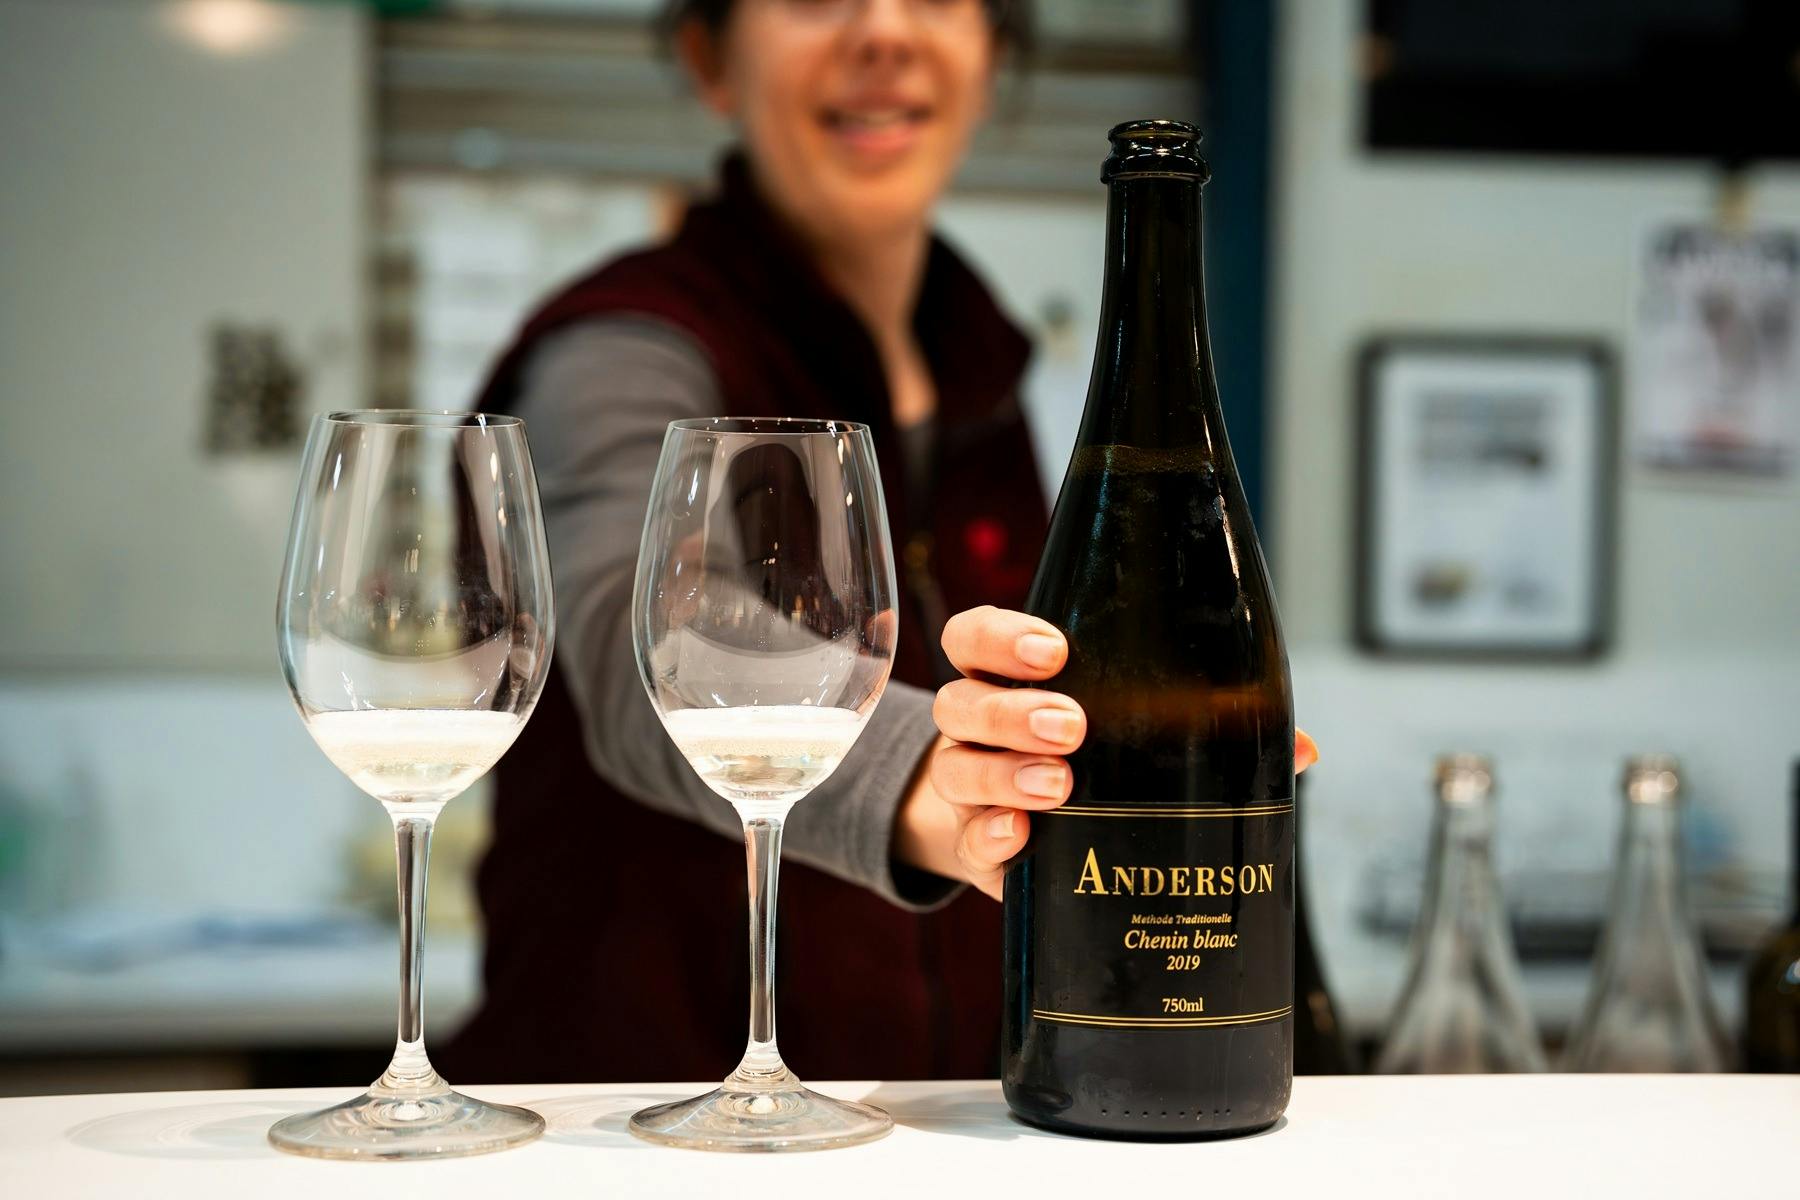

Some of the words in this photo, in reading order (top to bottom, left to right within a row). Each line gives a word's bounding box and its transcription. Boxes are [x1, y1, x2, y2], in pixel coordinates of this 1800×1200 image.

[1073, 847, 1274, 896] ANDERSON
[1131, 913, 1174, 925] Methode
[1175, 913, 1233, 925] Traditionelle
[1124, 929, 1188, 949] Chenin
[1192, 929, 1238, 949] blanc
[1166, 955, 1201, 971] 2019
[1162, 997, 1204, 1013] 750ml
